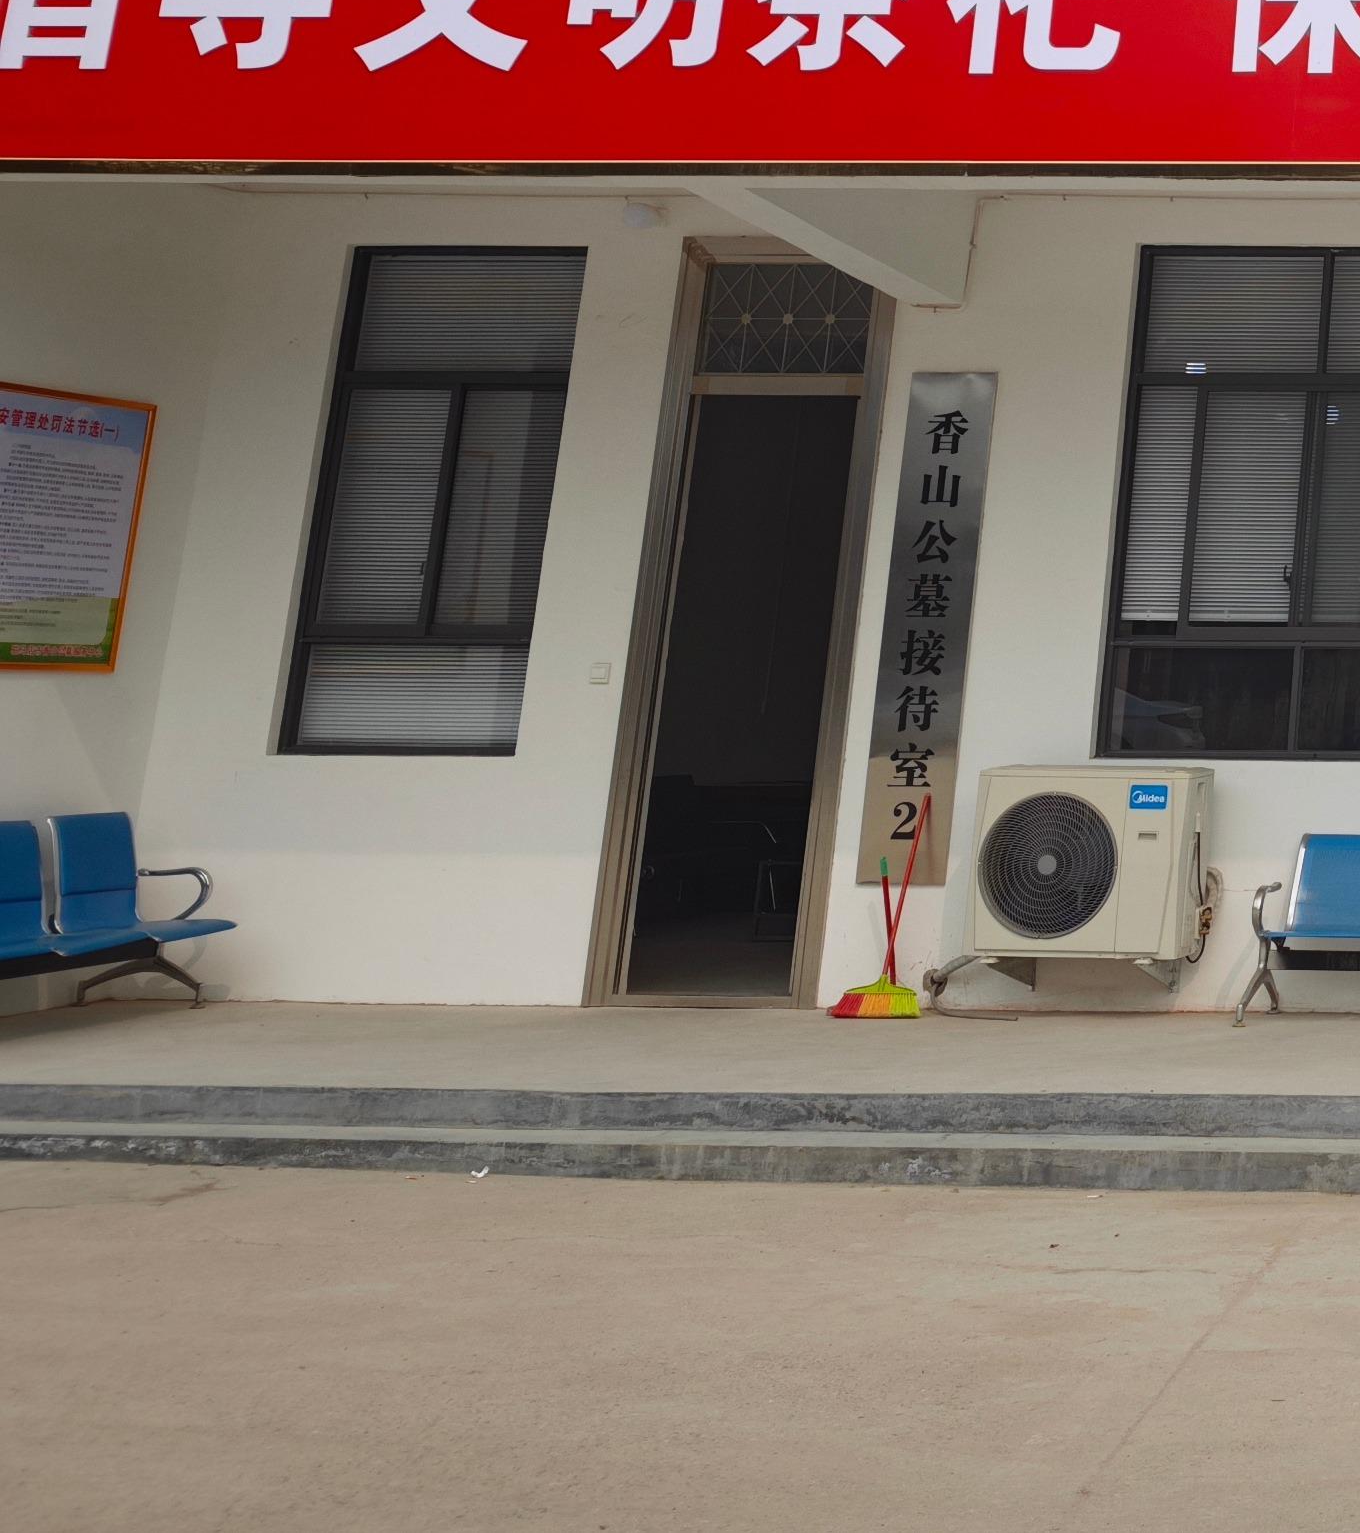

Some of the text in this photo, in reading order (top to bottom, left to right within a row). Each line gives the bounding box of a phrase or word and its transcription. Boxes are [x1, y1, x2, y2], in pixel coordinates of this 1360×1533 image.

[887, 409, 969, 841] 香山公墓接待室2
[1132, 791, 1165, 804] Midea
